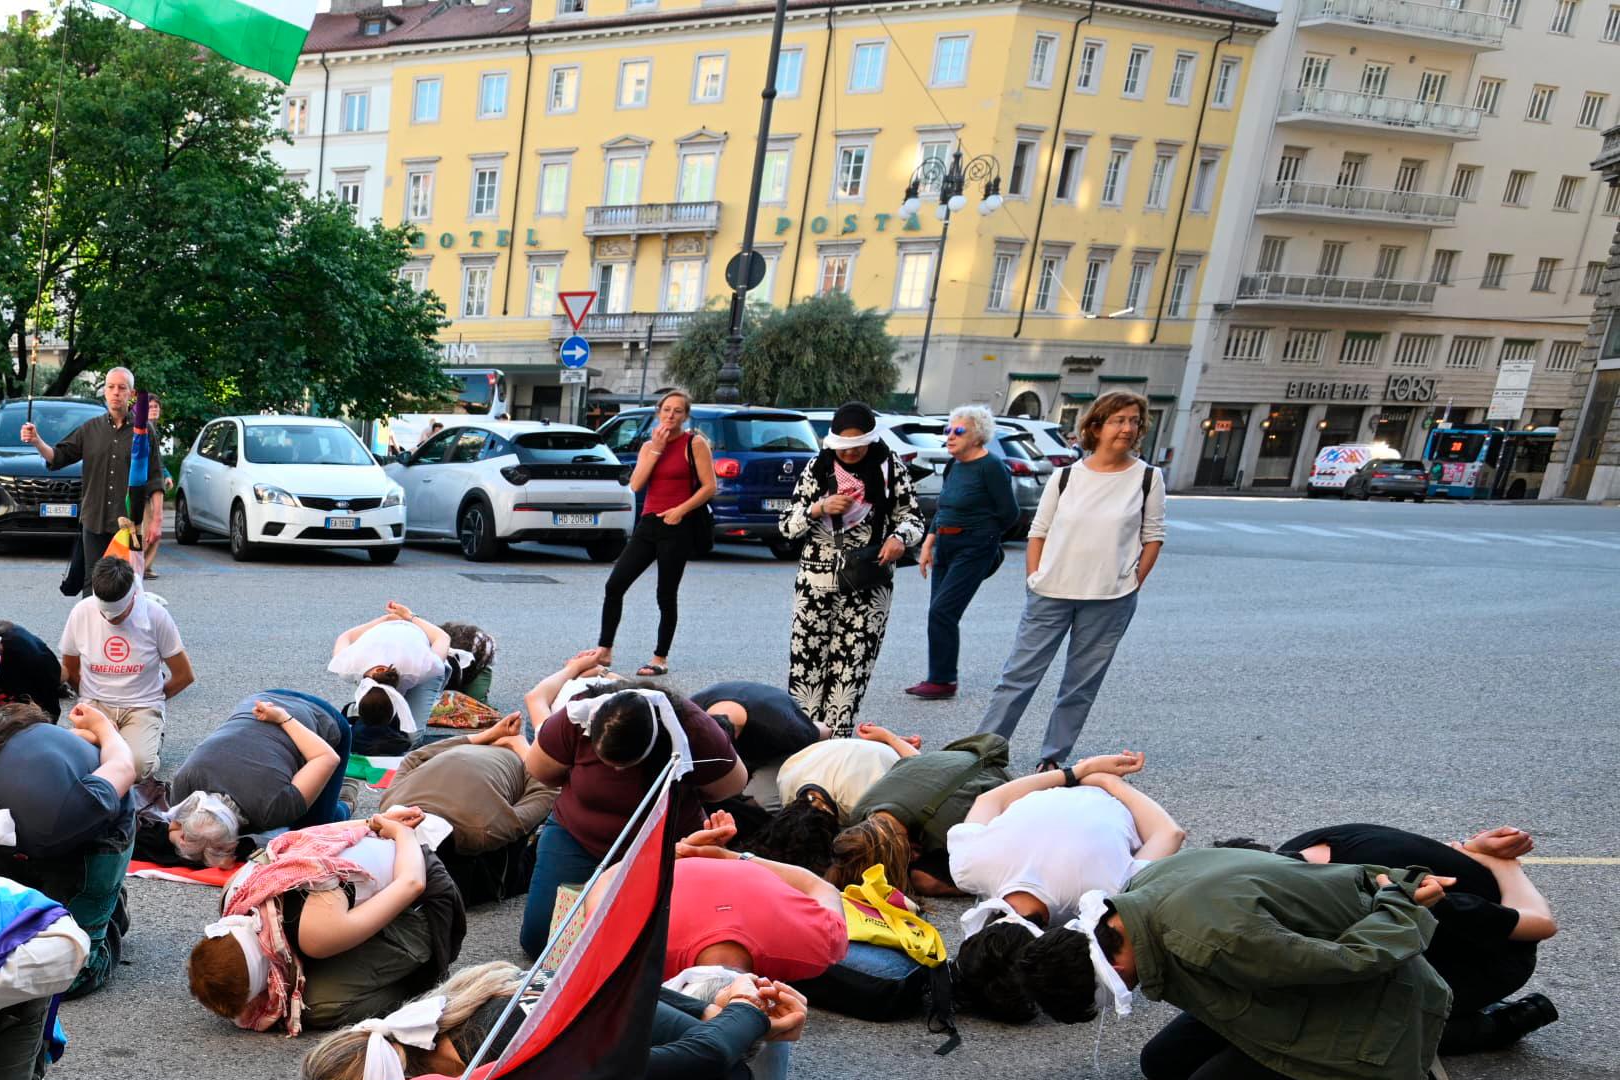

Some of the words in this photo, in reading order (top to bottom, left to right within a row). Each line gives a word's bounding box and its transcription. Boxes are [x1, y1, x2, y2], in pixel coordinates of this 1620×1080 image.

[775, 213, 921, 236] POSTA
[1285, 381, 1372, 400] BIRRERIA
[1384, 375, 1442, 401] FORST
[90, 664, 145, 674] EMERGENCY
